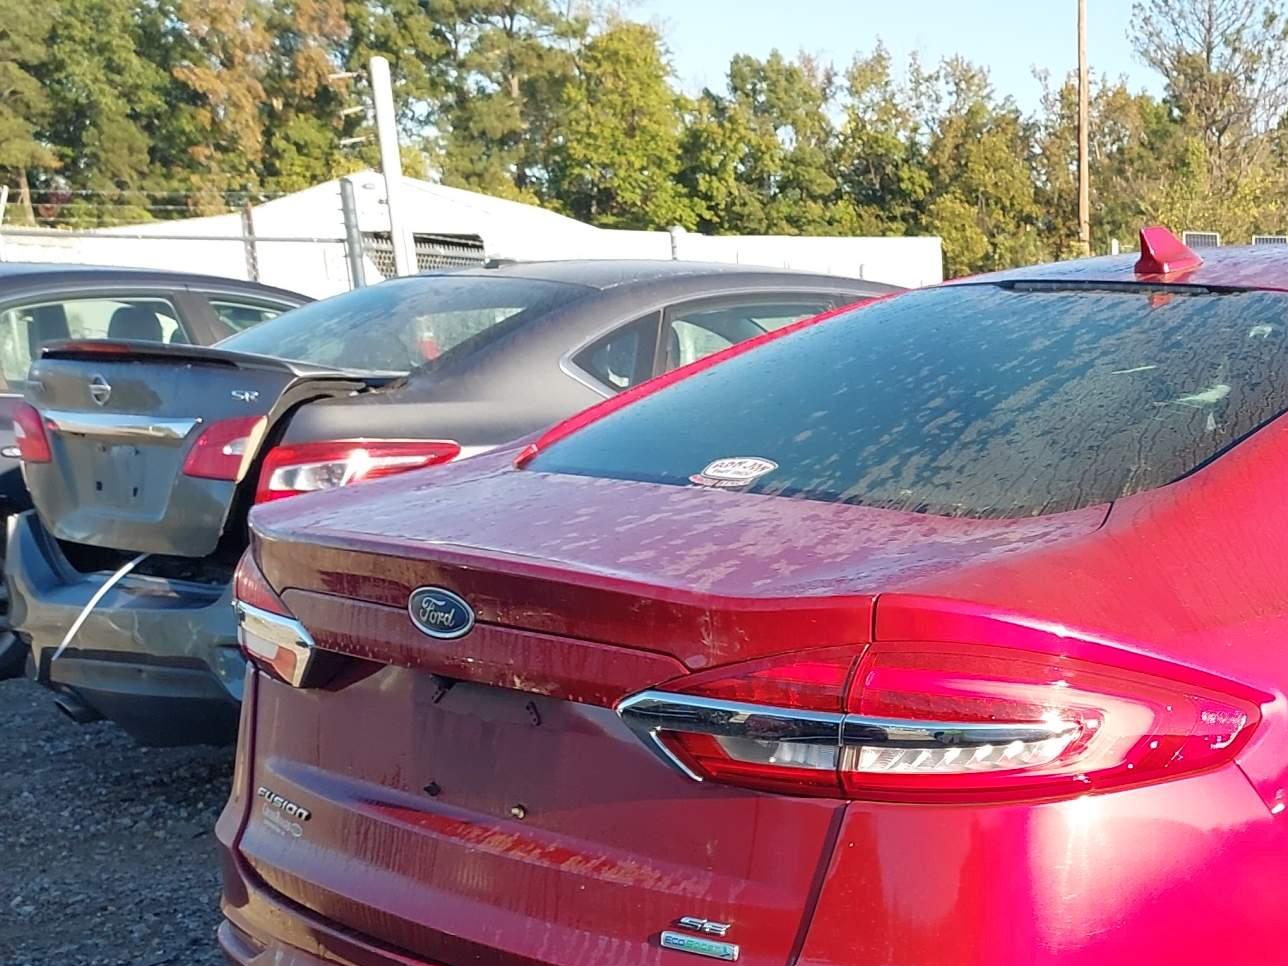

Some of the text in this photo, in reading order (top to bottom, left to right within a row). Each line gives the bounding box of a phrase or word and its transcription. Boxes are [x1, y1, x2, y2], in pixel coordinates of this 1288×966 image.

[420, 597, 455, 626] Ford
[258, 786, 310, 820] FUSION
[680, 916, 731, 936] SE
